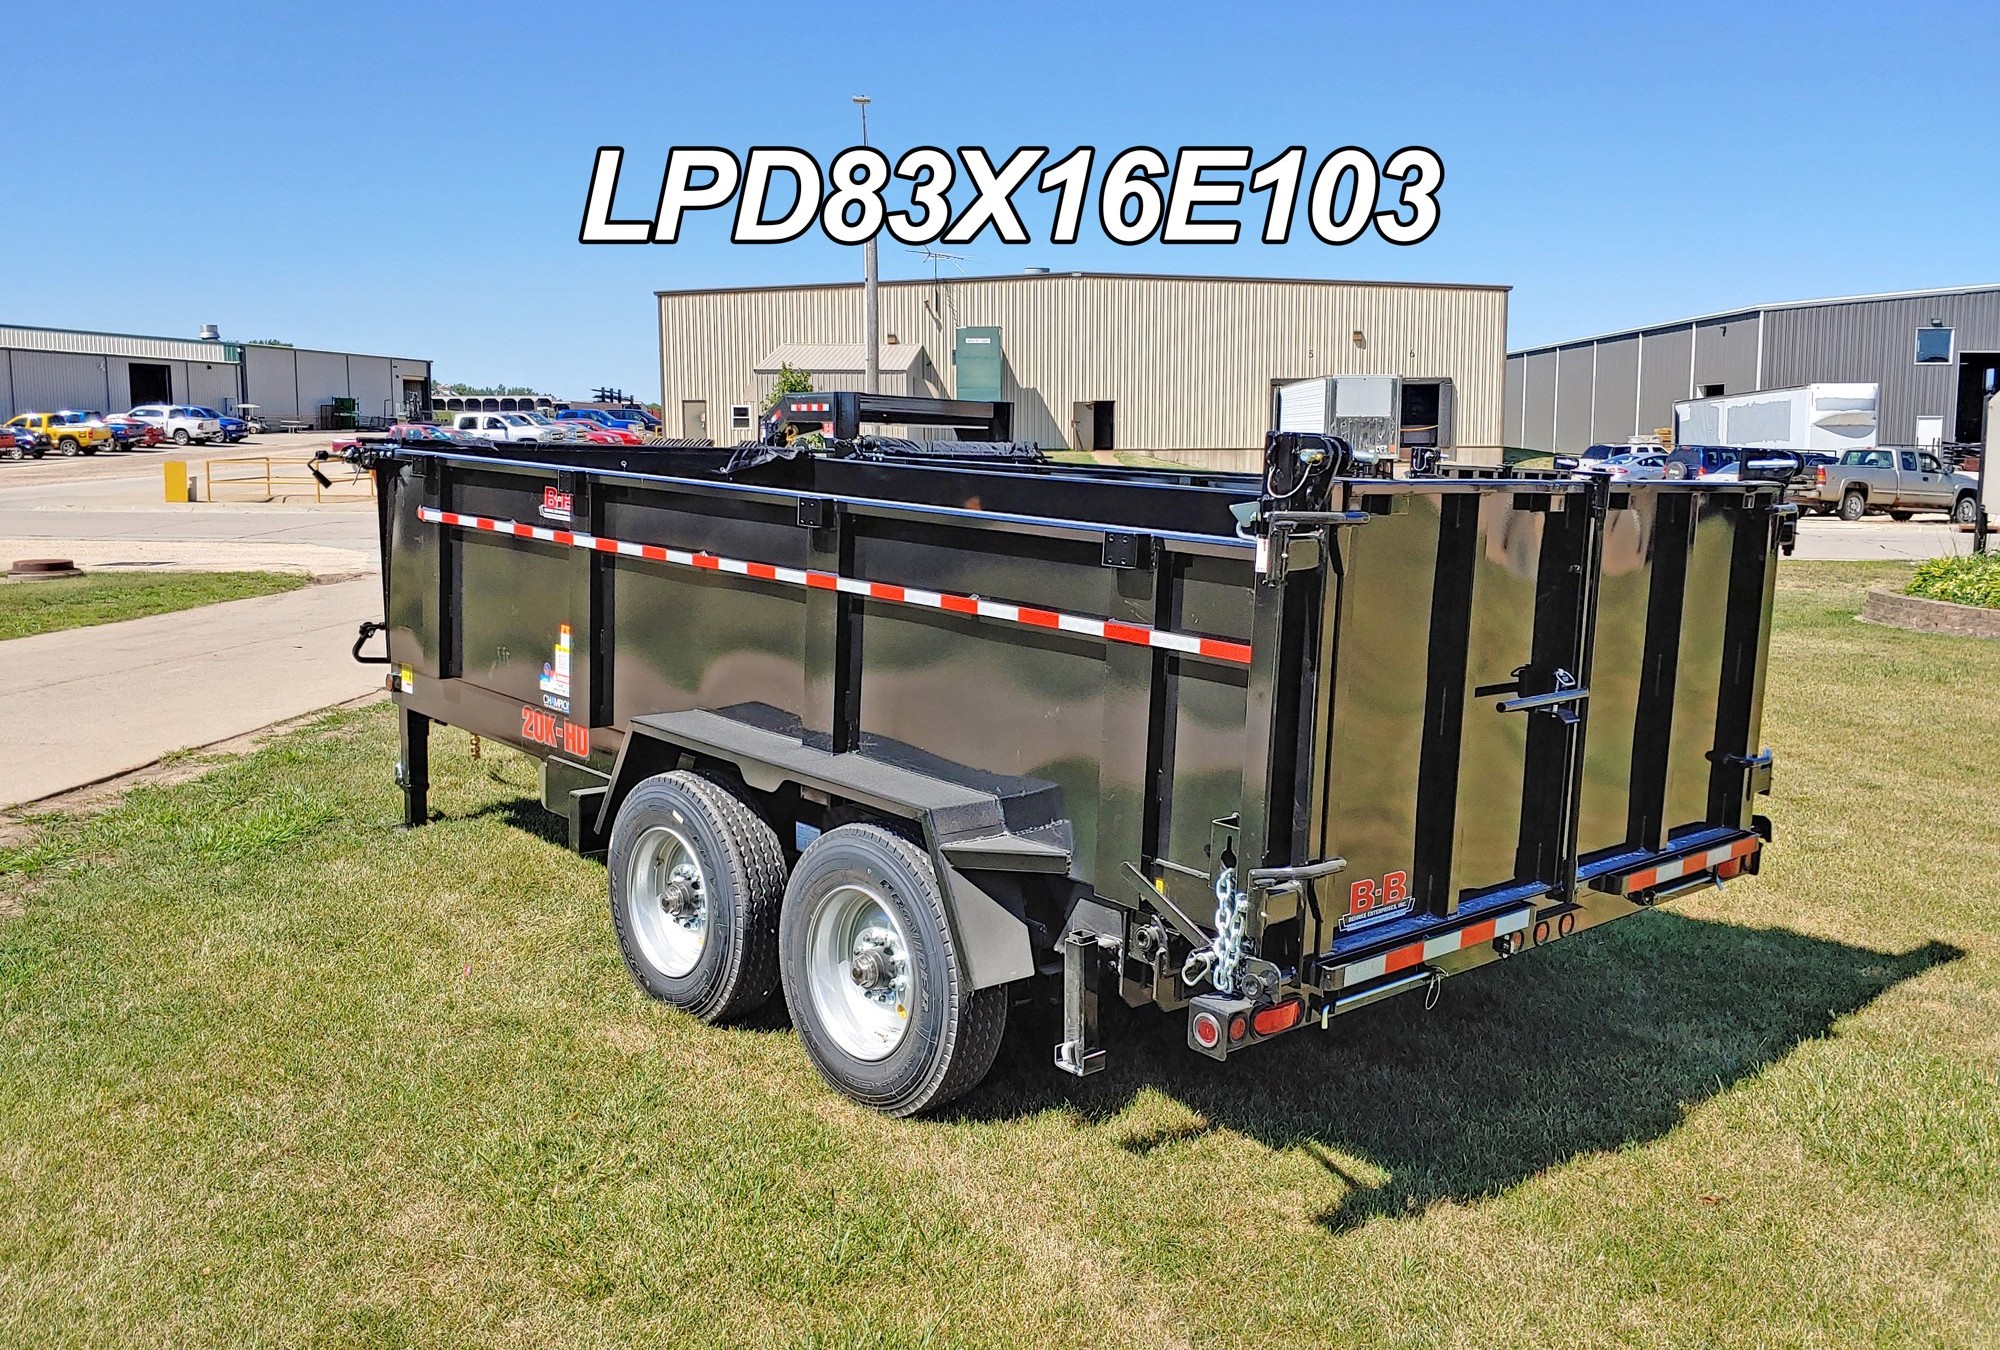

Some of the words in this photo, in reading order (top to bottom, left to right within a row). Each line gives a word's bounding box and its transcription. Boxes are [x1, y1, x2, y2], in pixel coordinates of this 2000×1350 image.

[1308, 349, 1314, 358] 5
[1409, 349, 1415, 358] 6
[522, 705, 590, 758] 20K-HD
[879, 878, 932, 1014] PROVIDER
